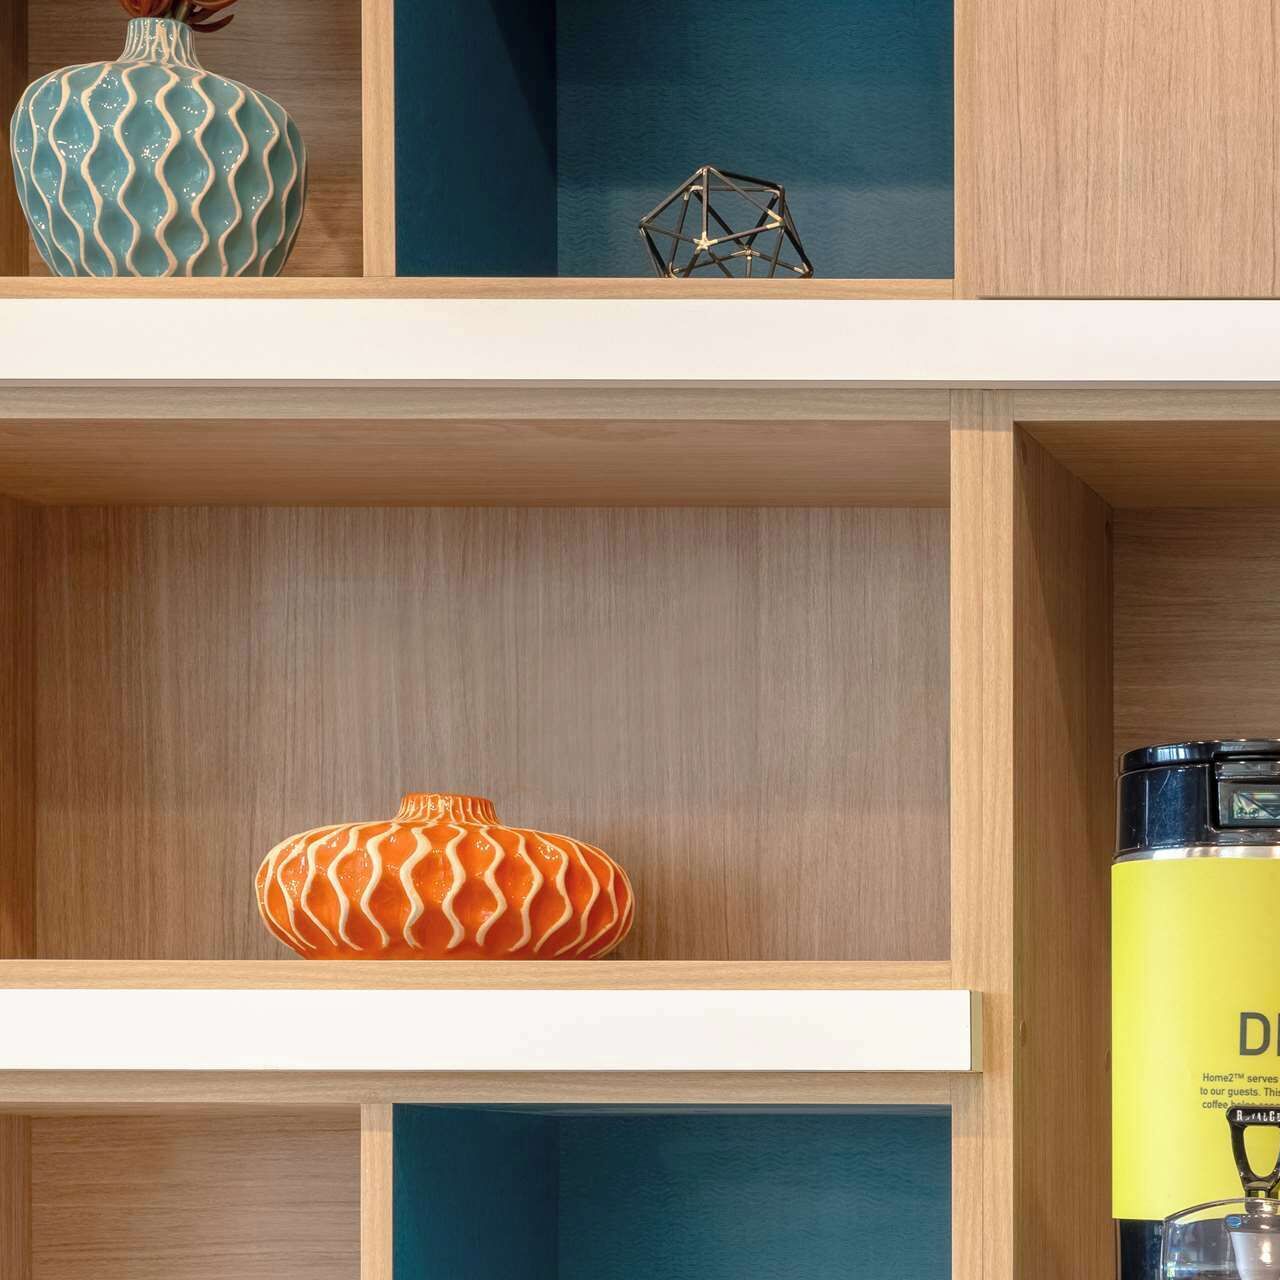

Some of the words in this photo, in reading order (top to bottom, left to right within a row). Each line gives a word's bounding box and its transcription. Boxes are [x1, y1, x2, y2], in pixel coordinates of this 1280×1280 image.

[1247, 1075, 1279, 1084] serves
[1200, 1087, 1208, 1095] to
[1210, 1088, 1225, 1096] our
[1227, 1087, 1261, 1098] guests.
[1202, 1100, 1228, 1109] coffee
